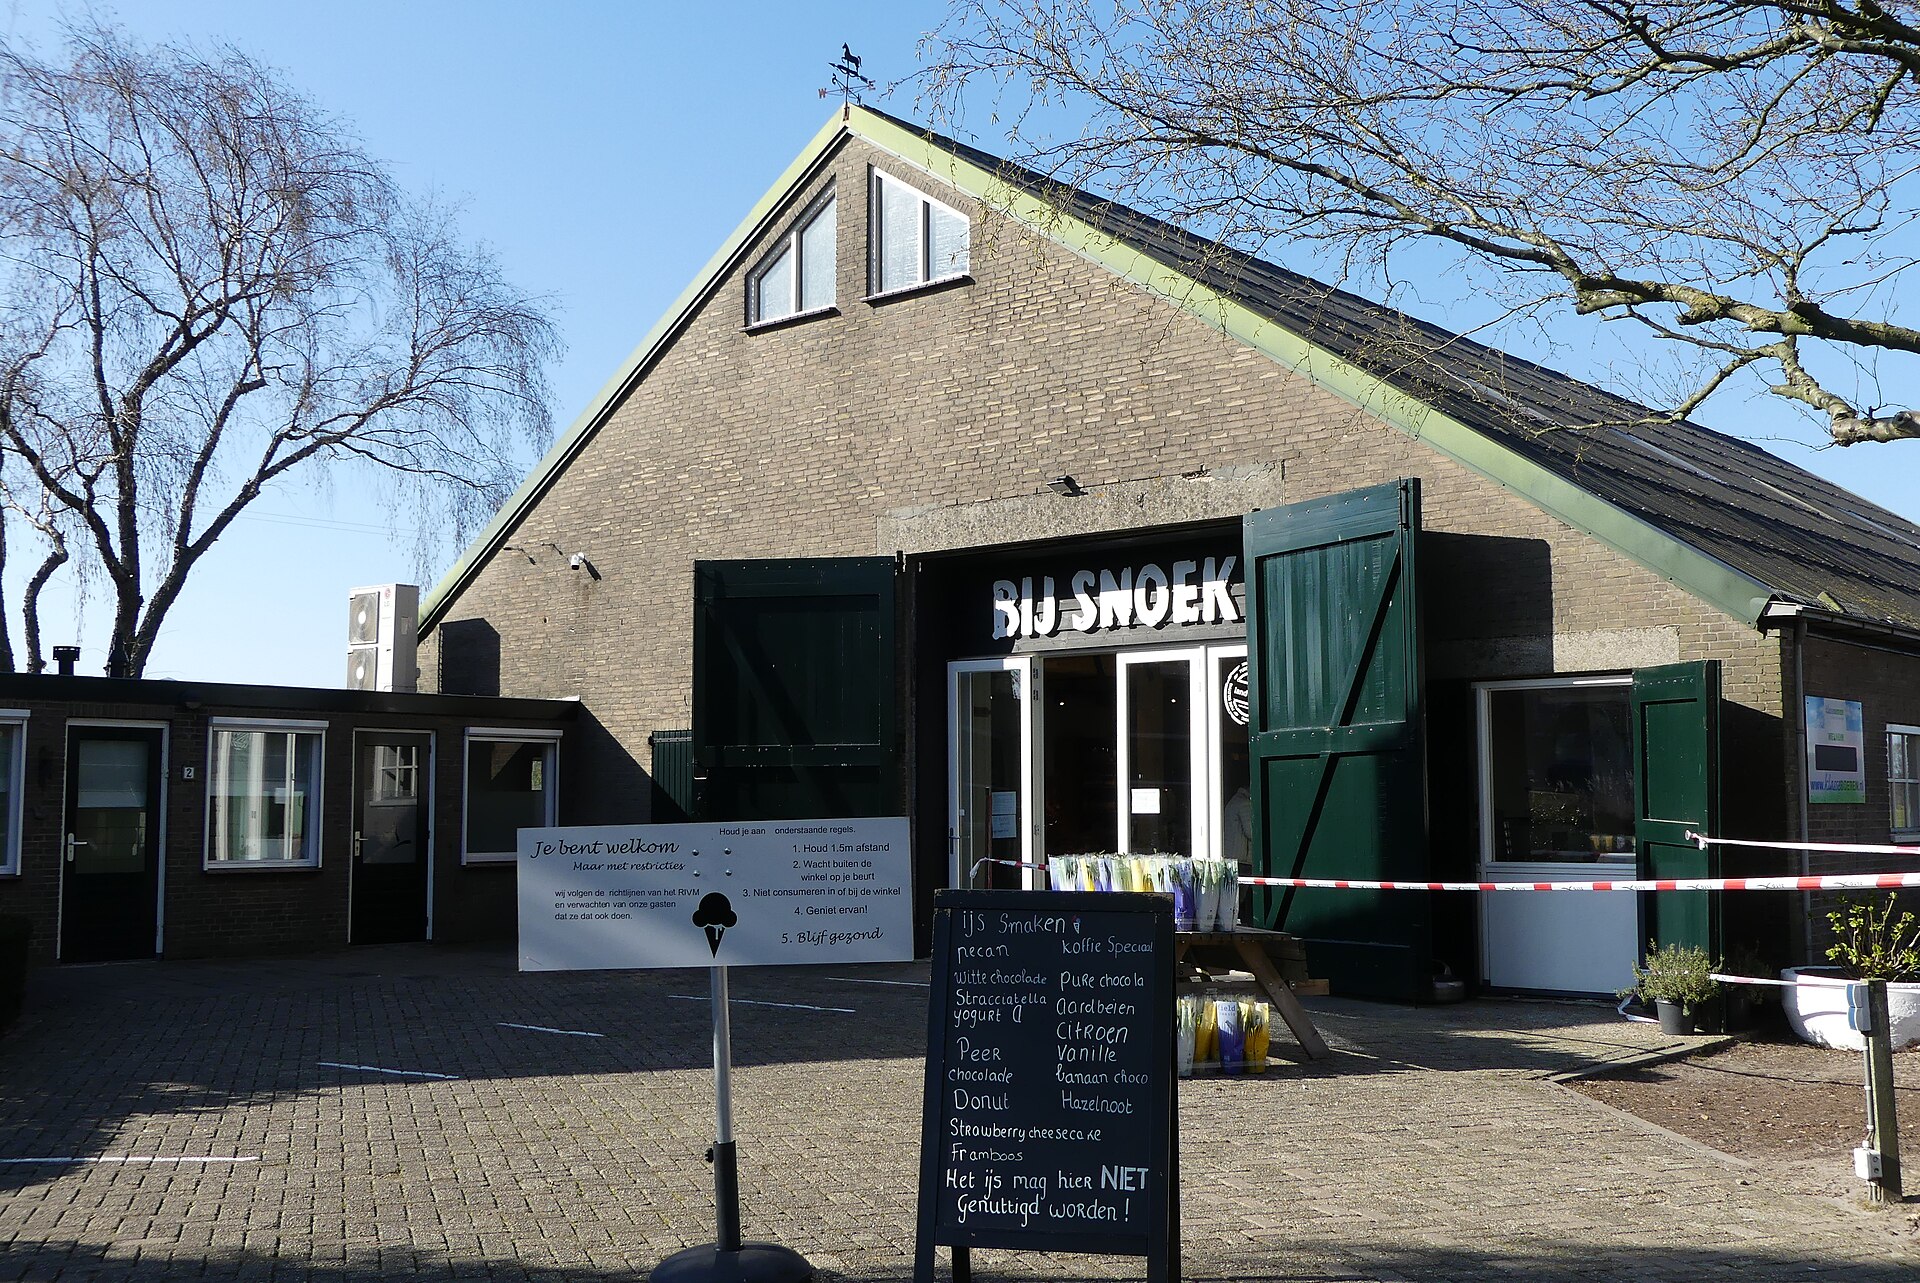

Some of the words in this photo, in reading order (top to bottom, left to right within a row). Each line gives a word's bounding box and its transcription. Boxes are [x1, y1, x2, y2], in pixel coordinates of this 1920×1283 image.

[992, 576, 1058, 640] BIJ
[1071, 556, 1239, 632] SNOEK
[186, 767, 192, 777] 2
[719, 827, 740, 836] Houd
[741, 827, 749, 837] je
[774, 826, 828, 835] onderstaande
[829, 825, 856, 835] regels.
[530, 841, 556, 859] Je
[559, 840, 603, 855] bent
[606, 838, 680, 855] welkom
[793, 845, 801, 853] 1.
[803, 844, 828, 853] Houd
[831, 843, 853, 852] 1.5m
[855, 843, 890, 852] afstand
[573, 861, 604, 872] Maar
[606, 862, 628, 871] met
[630, 861, 686, 871] restricties
[792, 860, 801, 869] 2.
[803, 860, 831, 869] Wacht
[833, 859, 859, 868] buiten
[861, 859, 872, 868] de
[801, 873, 828, 881] winkel
[830, 874, 841, 882] op
[842, 873, 851, 883] je
[853, 872, 875, 881] beurt
[555, 889, 566, 898] wij
[567, 889, 593, 898] volgen
[594, 889, 605, 897] de
[609, 888, 646, 898] richtlijnen
[664, 888, 676, 896] het
[678, 888, 700, 896] RIVM
[742, 889, 751, 897] 3.
[753, 888, 771, 896] Niet
[772, 888, 826, 897] consumeren
[828, 887, 836, 895] in
[838, 887, 847, 896] of
[848, 887, 858, 897] bij
[860, 887, 871, 896] de
[873, 886, 901, 896] winkel
[566, 900, 610, 909] verwachten
[650, 900, 676, 910] gasten
[794, 906, 803, 916] 4.
[805, 905, 836, 915] Geniet
[838, 904, 868, 914] ervan!
[554, 912, 568, 920] dat
[580, 912, 593, 920] dat
[595, 912, 609, 920] ook
[611, 911, 633, 920] doen.
[781, 932, 793, 944] 5.
[796, 929, 828, 946] Blijf
[829, 926, 884, 945] gezond
[990, 968, 1047, 985] chocolade
[956, 988, 1047, 1006] Stracciatella
[948, 1067, 1014, 1084] chocolade
[1113, 1068, 1149, 1085] choco
[953, 1088, 1011, 1111] Donut
[1061, 1089, 1134, 1115] Hazelnoot
[951, 1142, 1024, 1162] Framboos
[945, 1168, 976, 1189] Het
[984, 1169, 1002, 1200] ijs
[1013, 1174, 1047, 1200] mag
[1101, 1164, 1149, 1192] NIET
[957, 1192, 1041, 1228] Genuttigd
